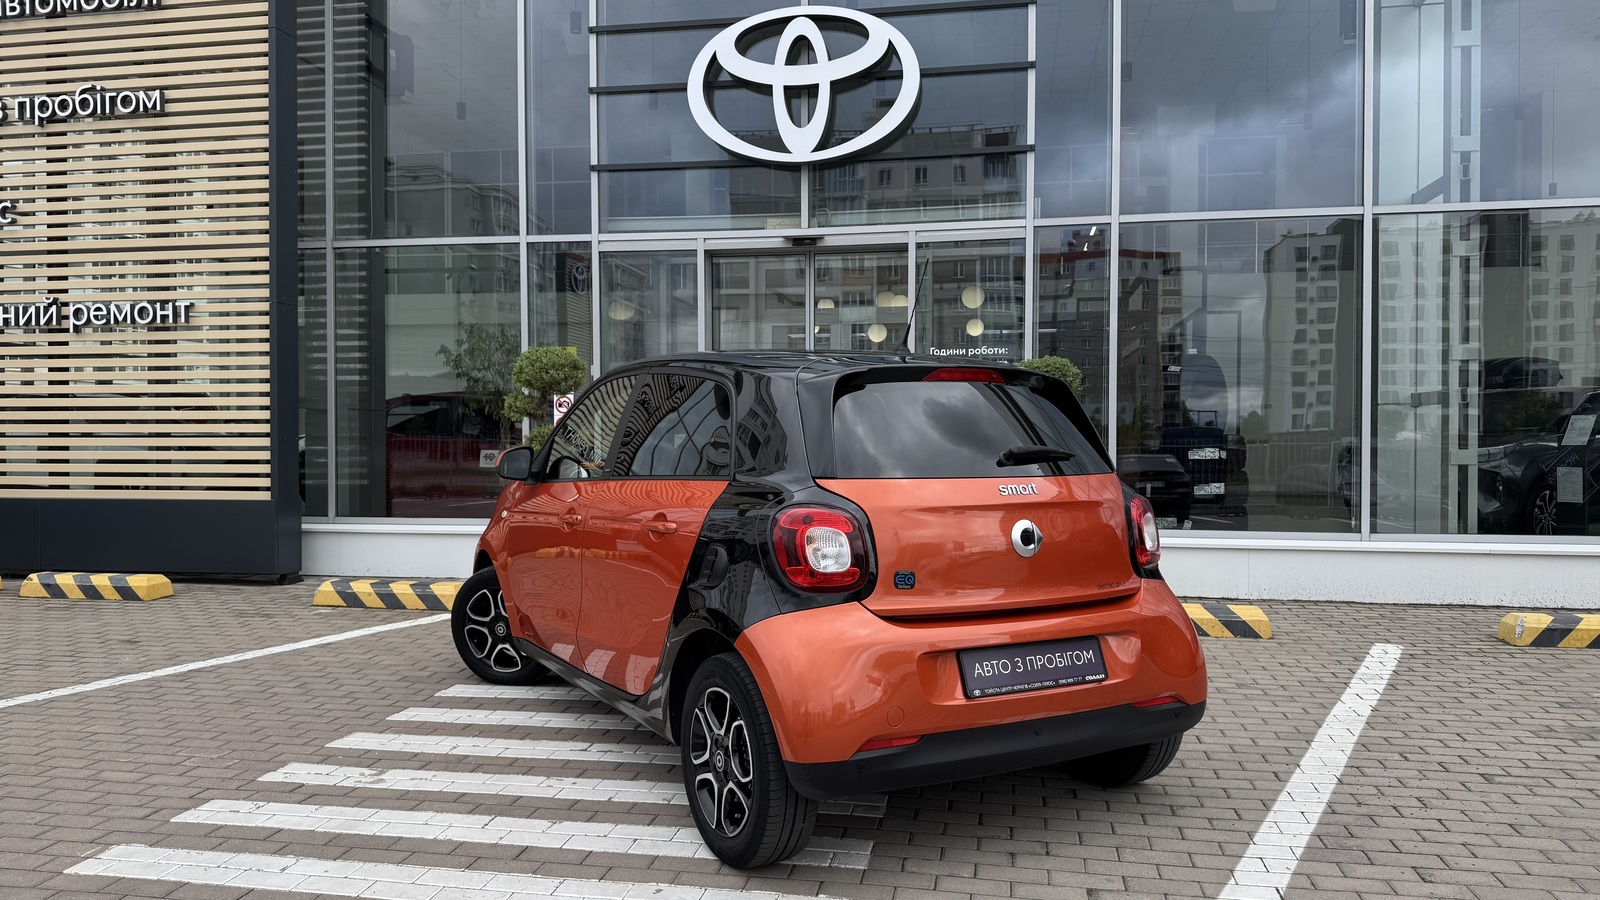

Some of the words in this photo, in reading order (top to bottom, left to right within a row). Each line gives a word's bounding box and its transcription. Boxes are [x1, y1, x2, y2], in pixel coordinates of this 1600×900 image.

[14, 84, 162, 126] пробігом
[69, 301, 191, 332] ремонт
[930, 347, 966, 356] Години
[968, 345, 1008, 357] роботи:
[999, 482, 1038, 496] smart
[895, 575, 914, 585] EQ
[974, 659, 1011, 678] АВТО
[1026, 649, 1095, 671] ПРОБІГОМ
